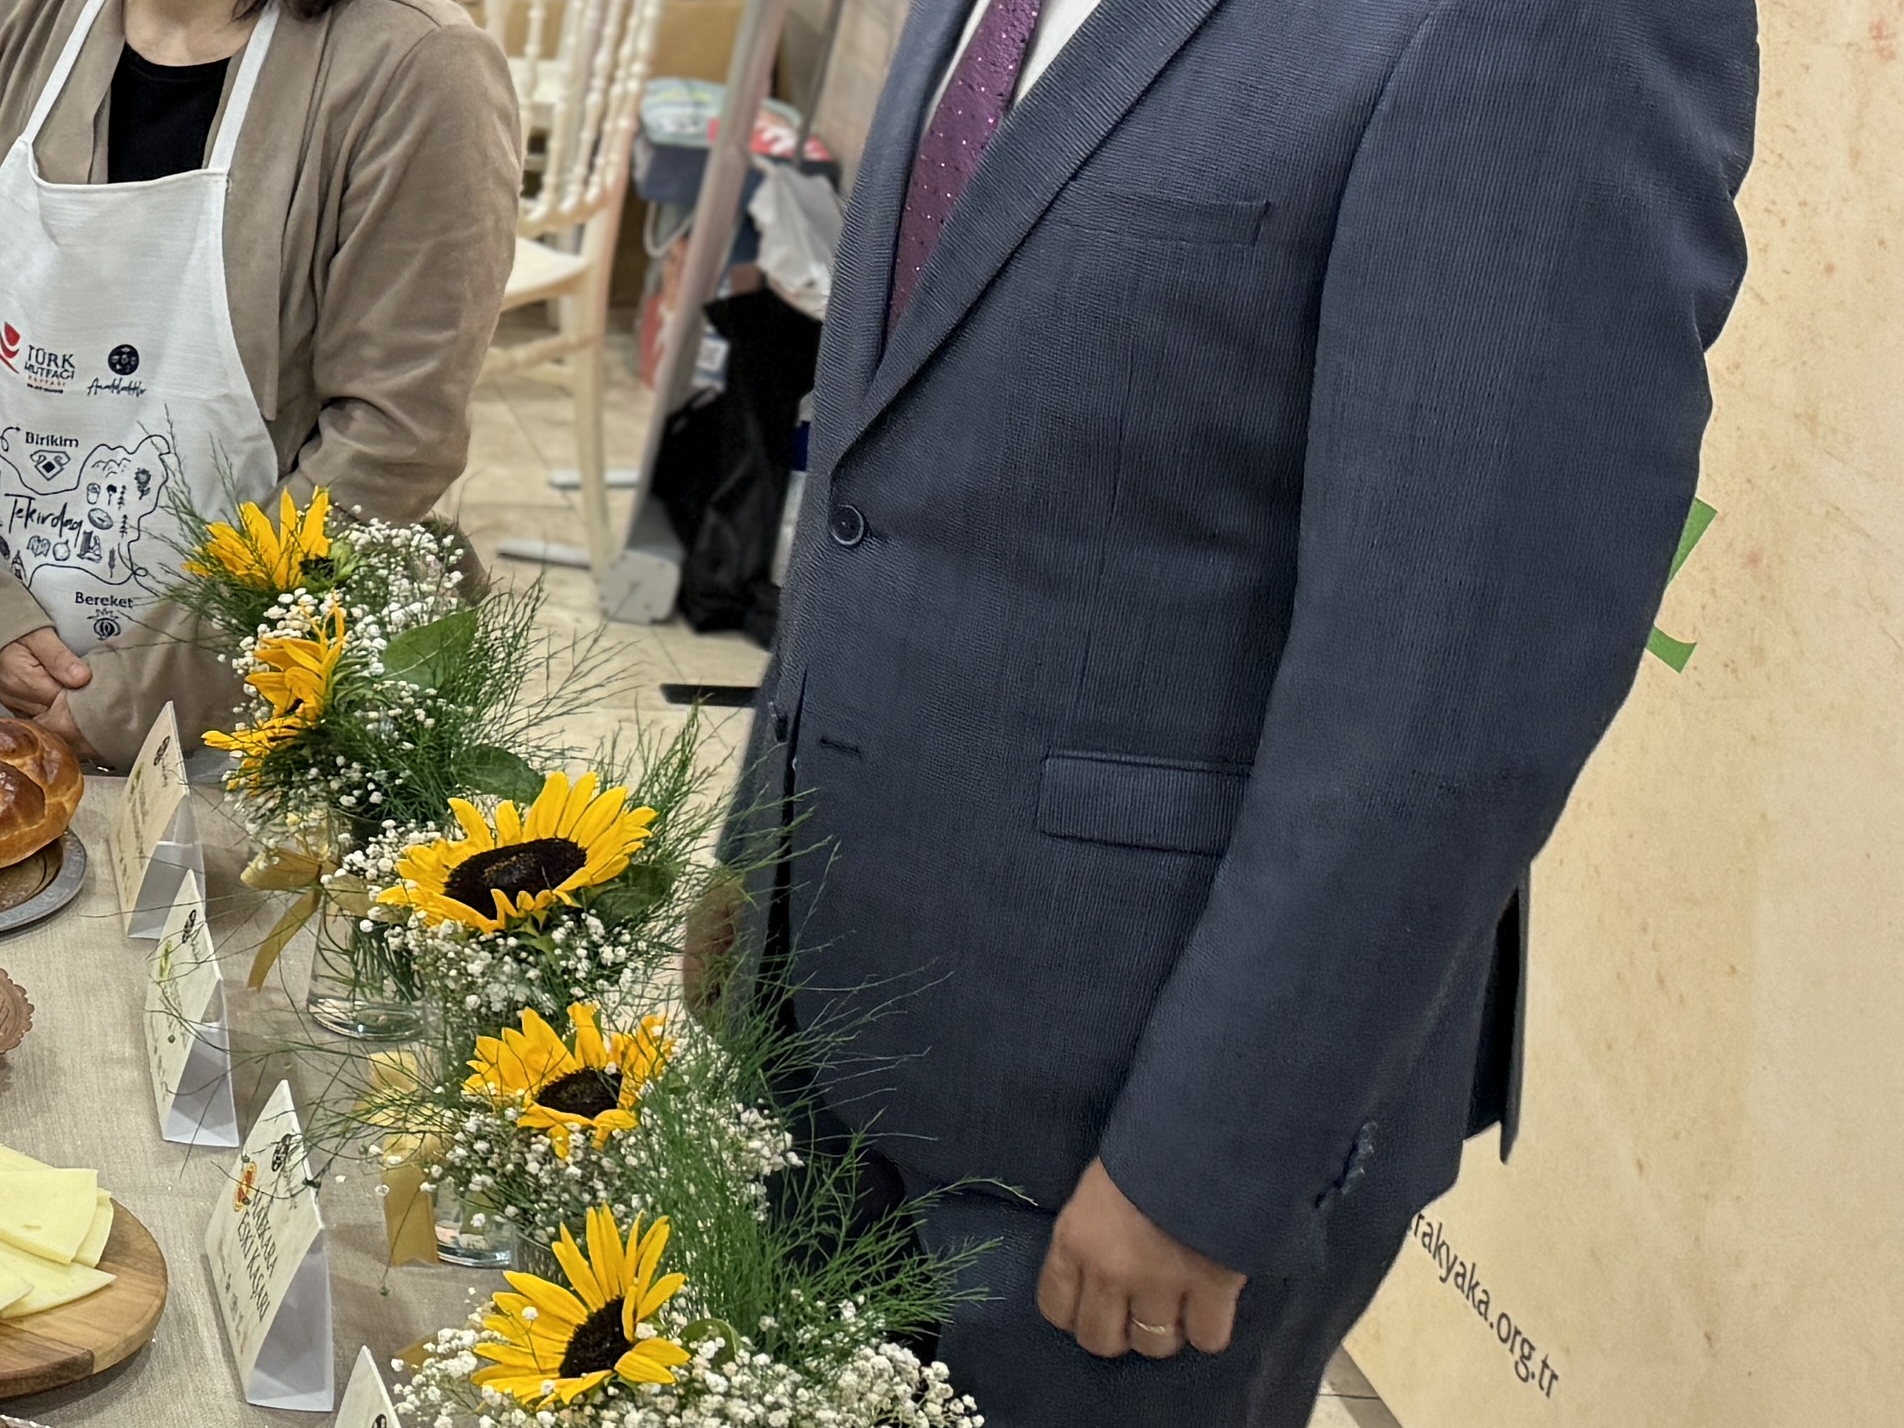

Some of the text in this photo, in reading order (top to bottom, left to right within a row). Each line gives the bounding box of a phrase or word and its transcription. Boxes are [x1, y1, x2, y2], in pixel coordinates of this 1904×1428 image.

[27, 345, 75, 369] TÜRK
[25, 431, 79, 448] Birikim
[75, 591, 133, 609] Bereket
[1409, 1212, 1560, 1400] rakyaka.org.tr
